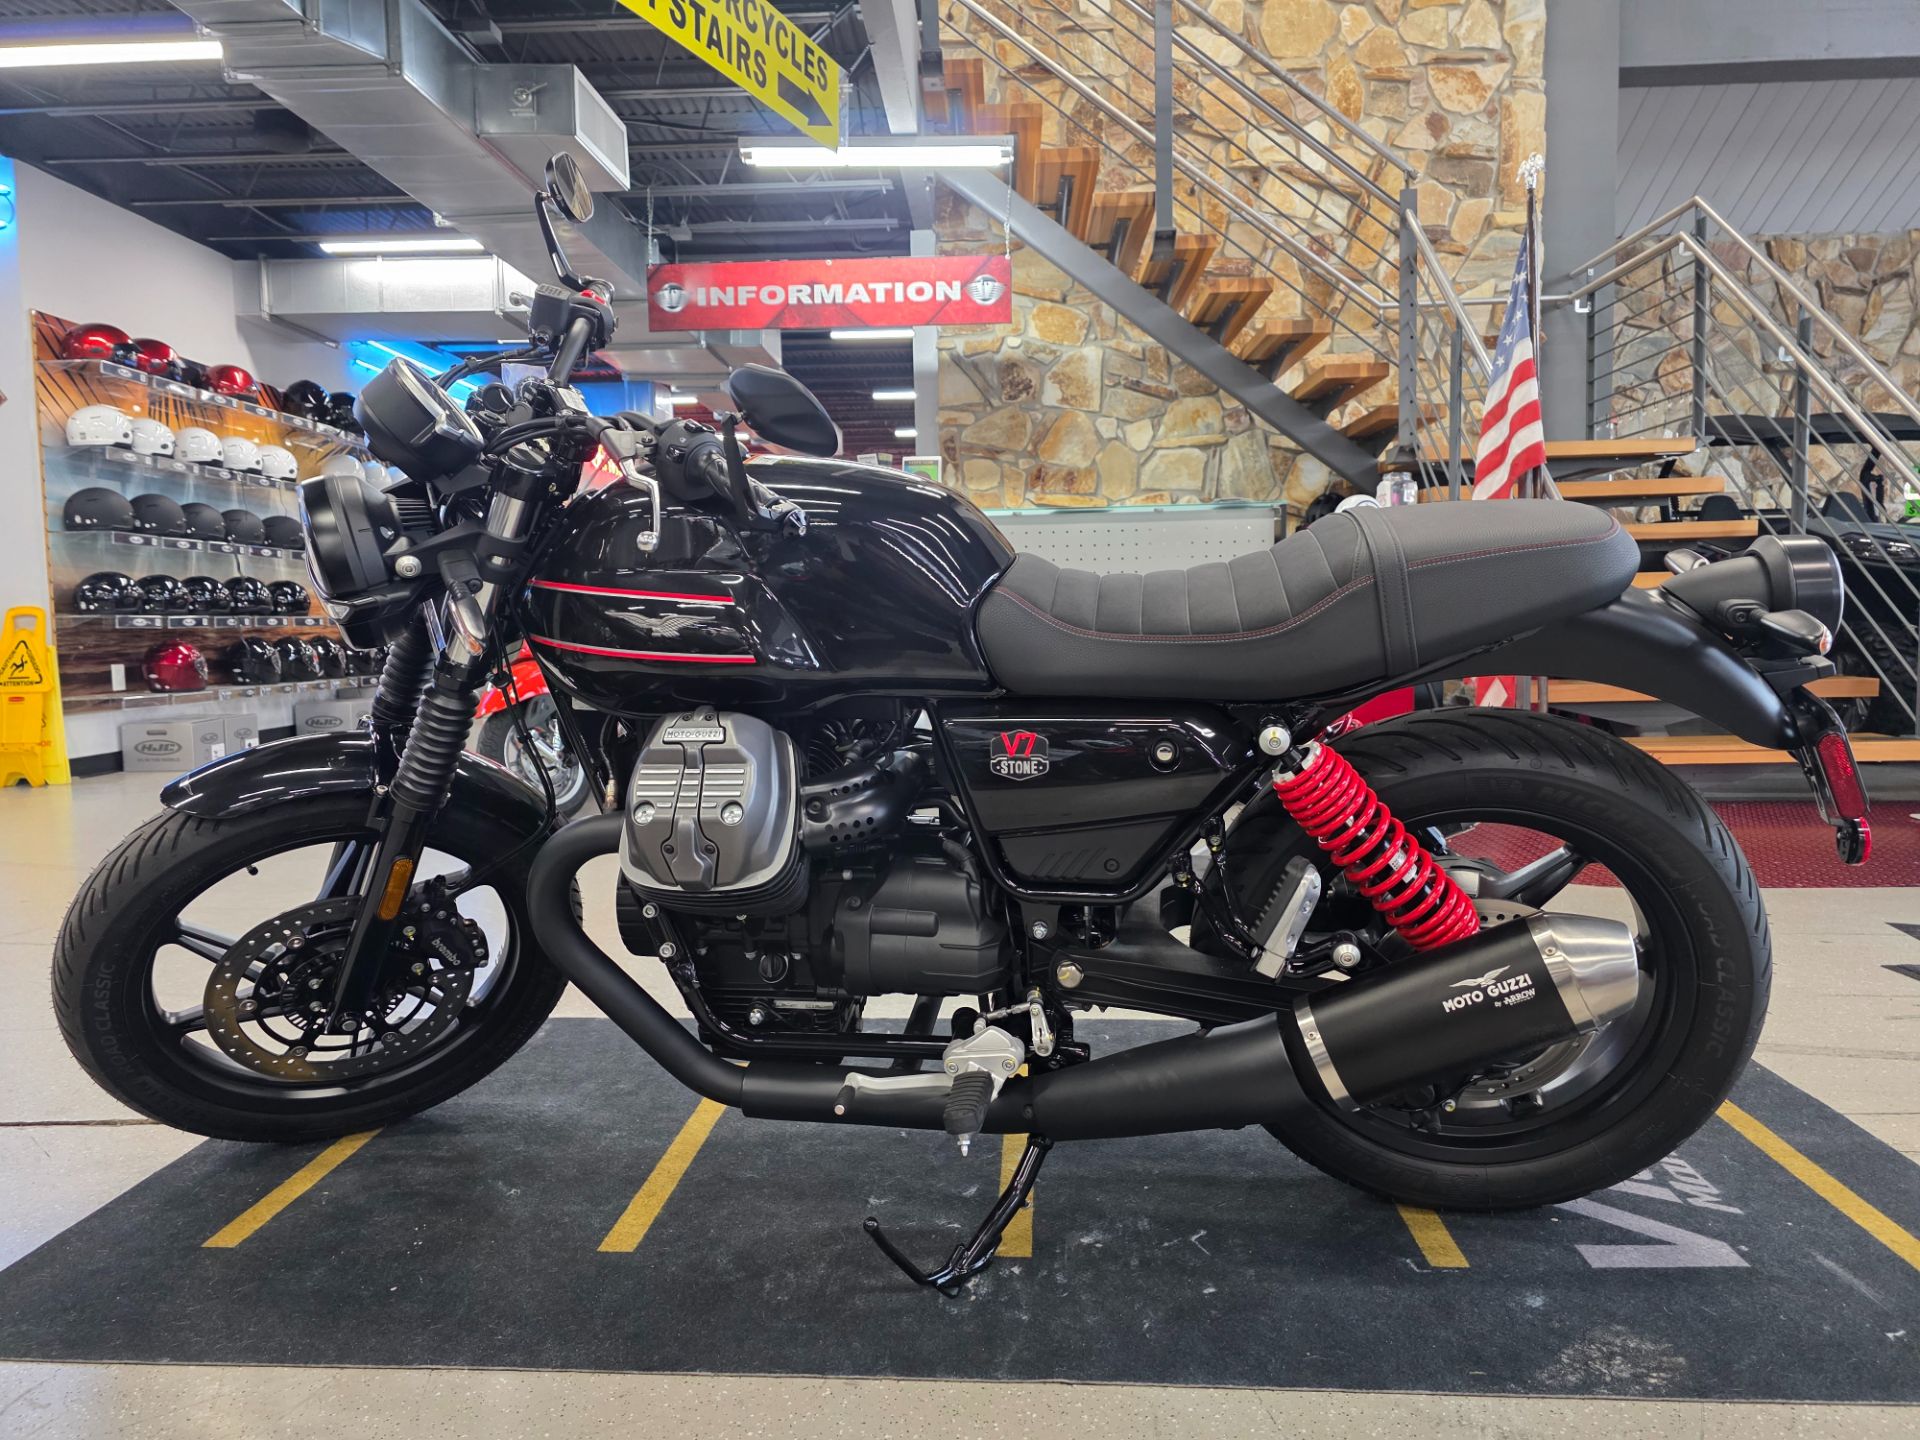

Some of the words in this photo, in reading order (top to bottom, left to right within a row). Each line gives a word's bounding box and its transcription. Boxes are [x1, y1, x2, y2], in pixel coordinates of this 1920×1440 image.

[648, 0, 767, 89] STAIRS
[696, 281, 962, 306] INFORMATION
[1001, 732, 1037, 757] V7
[1000, 761, 1038, 774] STONE
[431, 937, 461, 965] brembo
[94, 961, 117, 1032] CLASSIC
[1442, 990, 1484, 1013] MOTO
[1487, 973, 1533, 997] GUZZI
[1503, 988, 1536, 1005] ARROW
